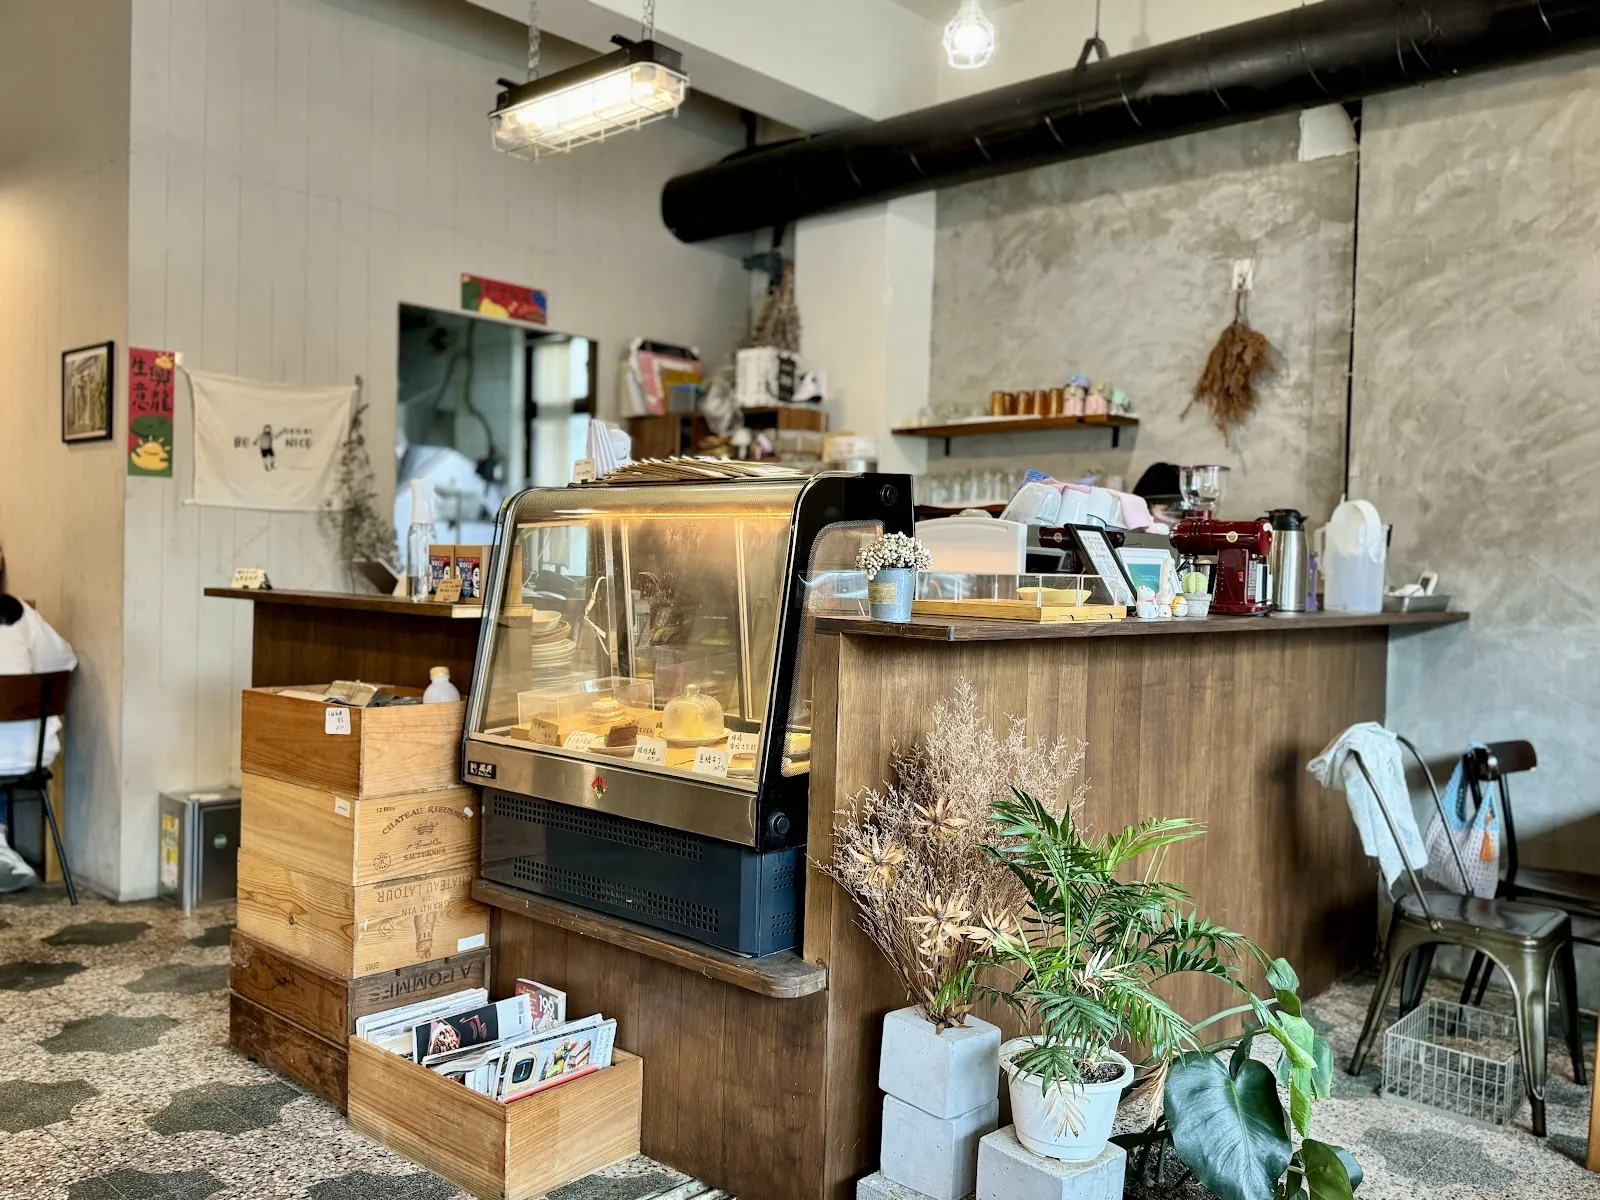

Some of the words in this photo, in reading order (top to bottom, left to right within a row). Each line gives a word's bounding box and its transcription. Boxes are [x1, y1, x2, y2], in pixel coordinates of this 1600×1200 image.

[233, 435, 250, 449] BE
[285, 437, 312, 450] NICE
[382, 807, 424, 835] CHATEAU
[427, 805, 468, 823] RIEUSSEC
[426, 874, 473, 894] CHATEAU
[377, 885, 421, 903] LATOUR
[401, 907, 417, 917] VIN
[420, 899, 450, 913] GRAND
